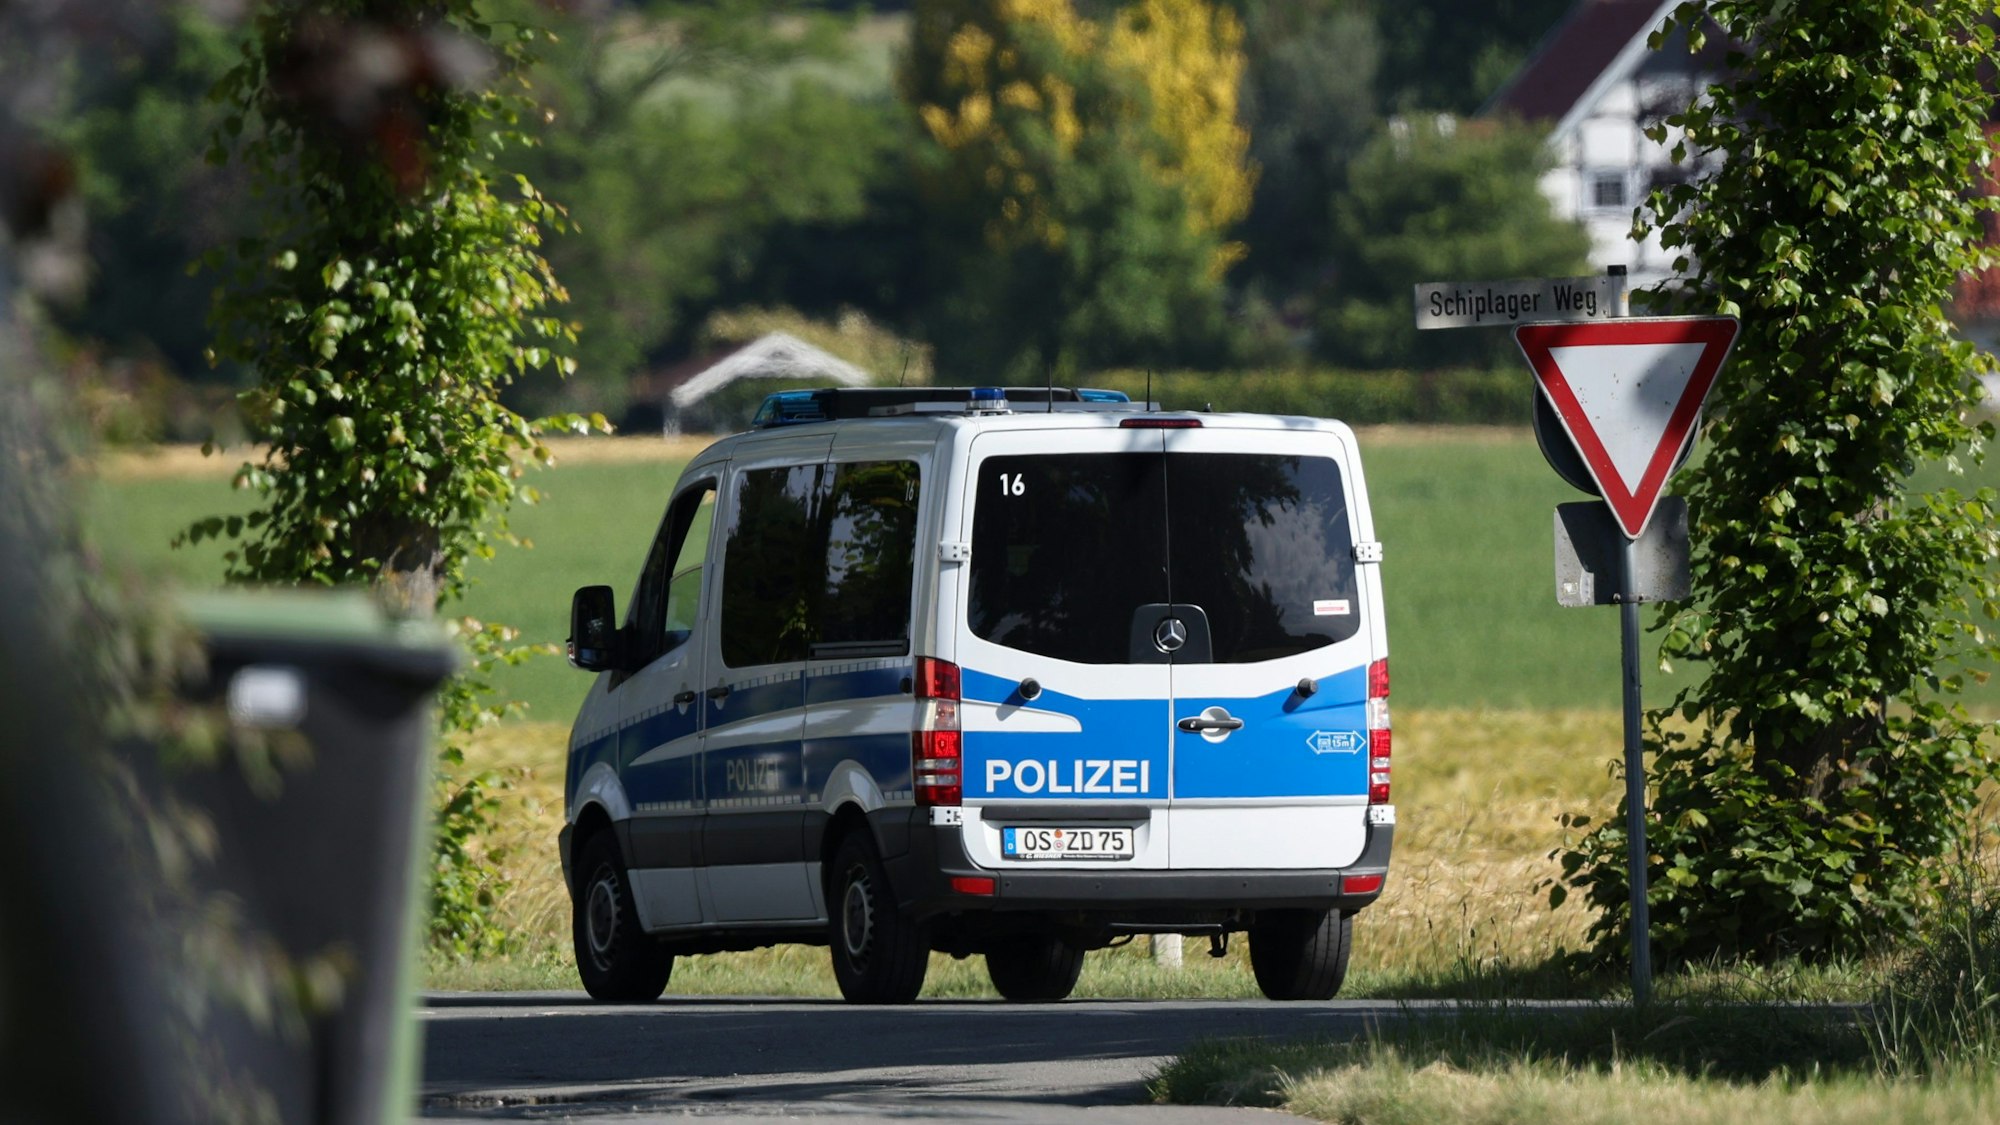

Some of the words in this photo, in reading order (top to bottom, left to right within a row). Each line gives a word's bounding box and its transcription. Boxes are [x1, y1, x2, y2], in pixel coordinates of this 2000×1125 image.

[1430, 288, 1541, 321] Schiplager
[1553, 285, 1597, 317] Weg
[905, 480, 915, 501] 16
[1000, 472, 1025, 496] 16
[726, 758, 780, 792] POLIZEI
[986, 759, 1149, 793] POLIZEI
[1024, 830, 1052, 850] OS
[1066, 831, 1094, 850] ZD
[1098, 831, 1125, 850] 75
